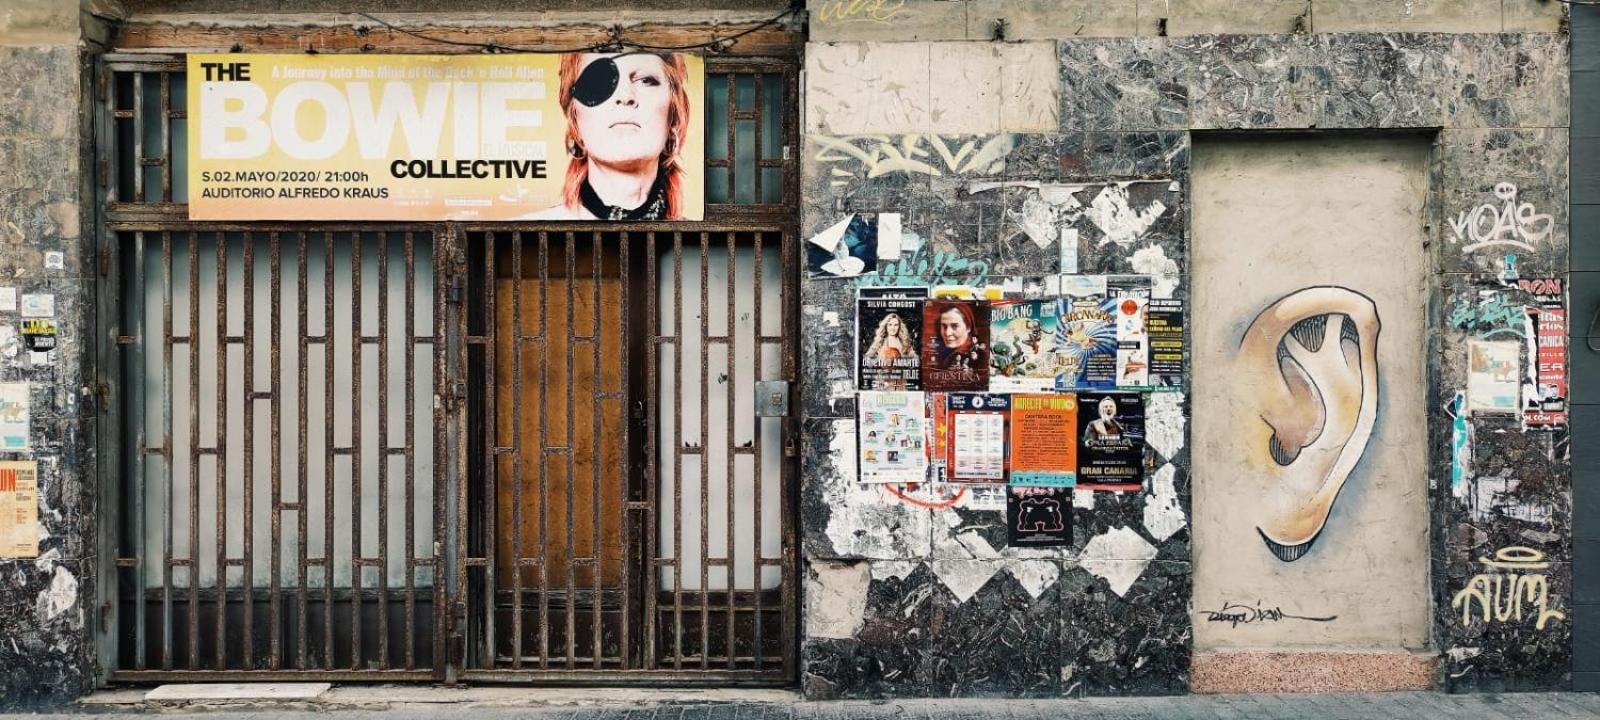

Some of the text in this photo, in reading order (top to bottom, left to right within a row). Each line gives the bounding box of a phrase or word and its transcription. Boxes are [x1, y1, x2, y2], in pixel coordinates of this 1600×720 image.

[201, 63, 251, 81] THE
[272, 66, 280, 79] A
[283, 65, 328, 82] Journey
[330, 65, 352, 79] into
[356, 66, 374, 79] the
[200, 81, 547, 160] BOWIE
[202, 171, 369, 183] S.02.MAYO/2020/ 21:00h
[390, 160, 547, 179] COLLECTIVE
[202, 187, 390, 199] AUDITORIO ALFREDO KRAUS
[1080, 466, 1102, 475] GRAN
